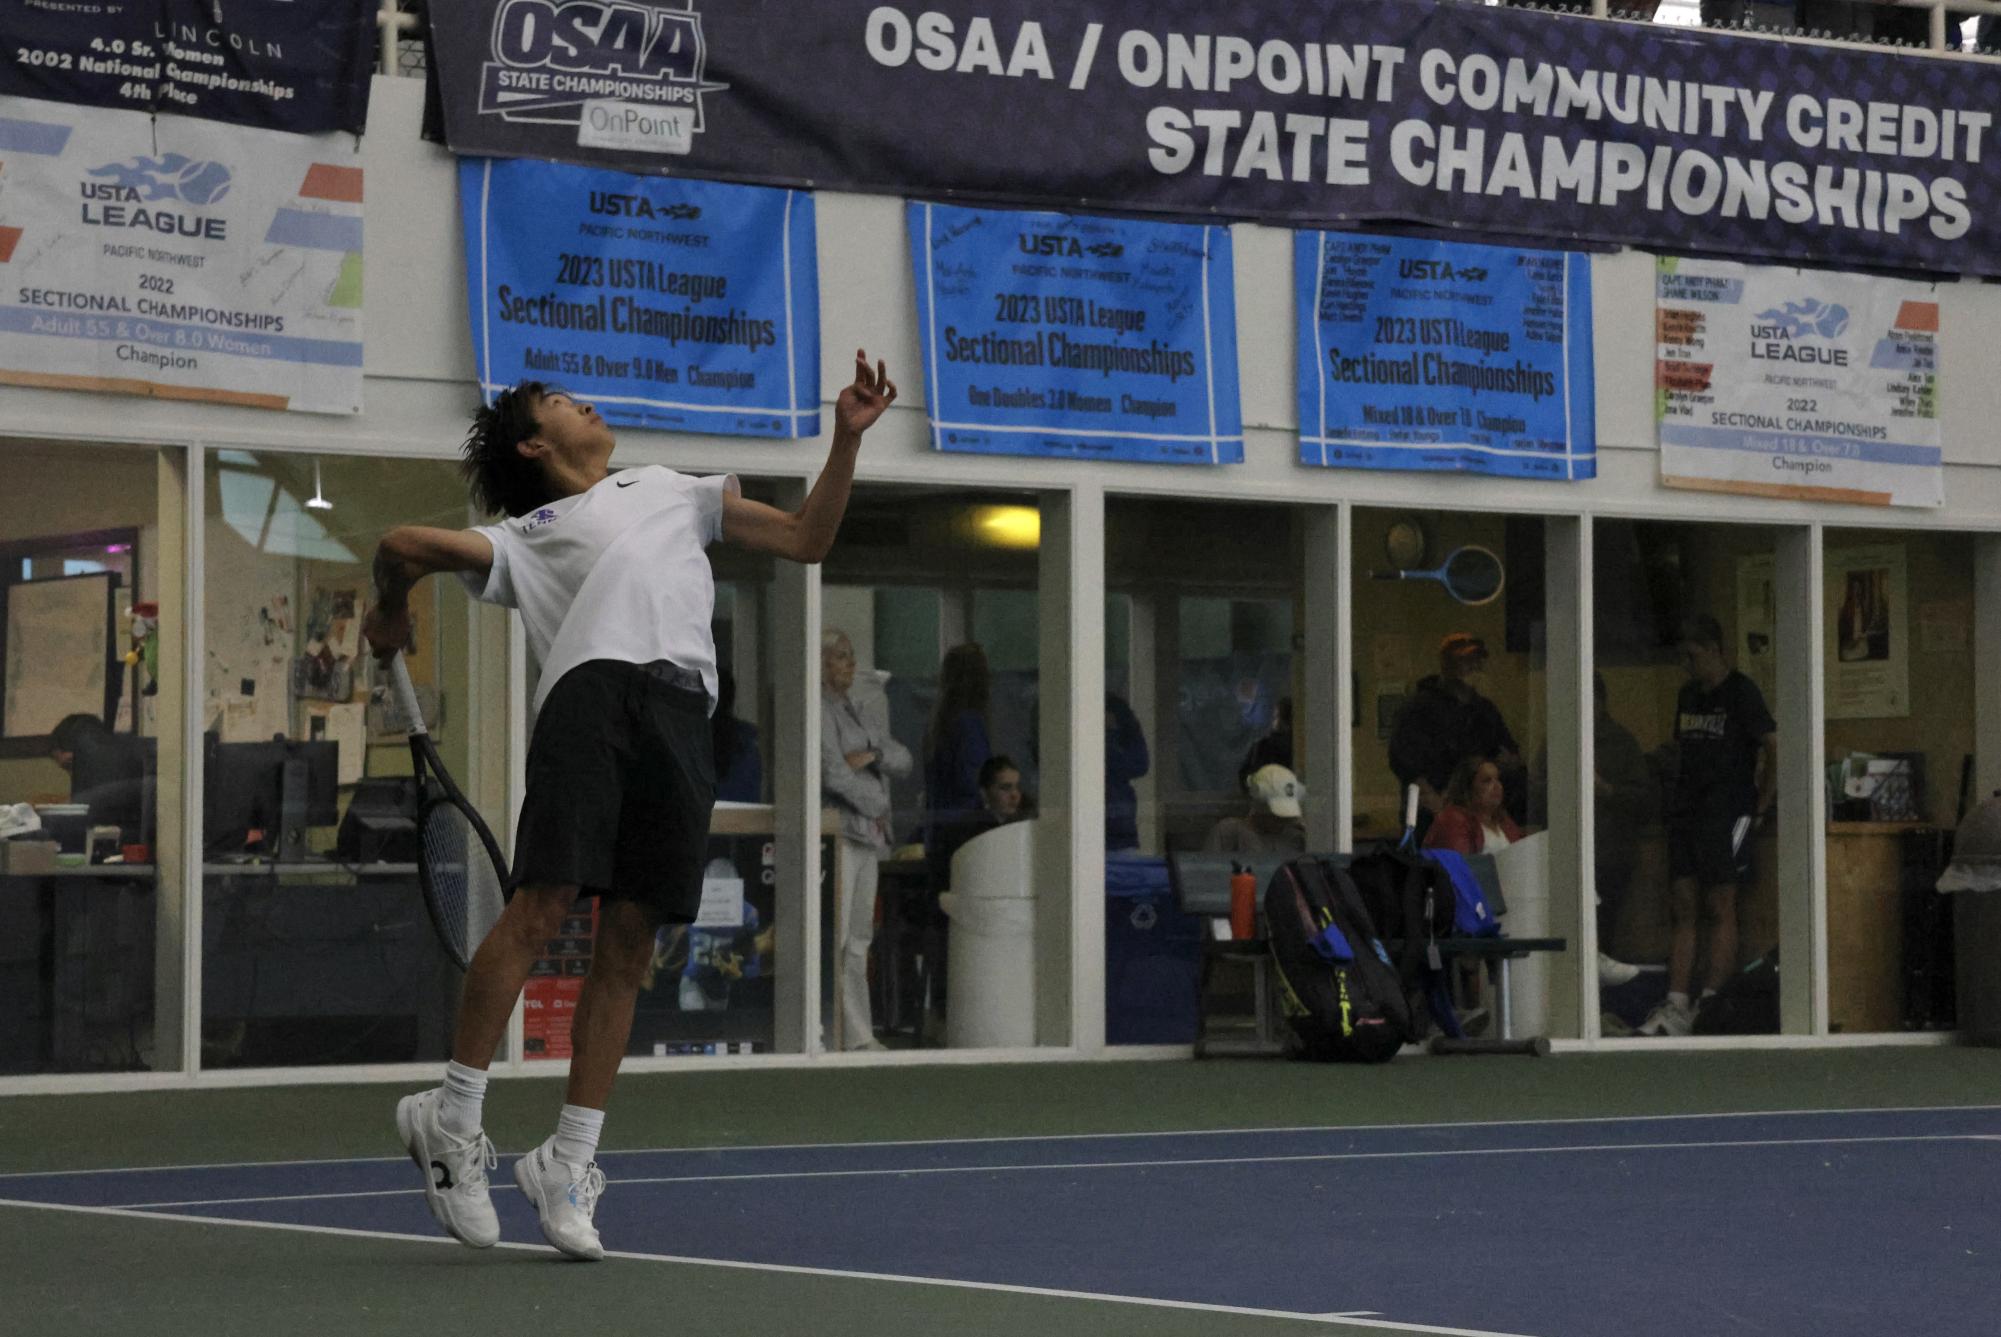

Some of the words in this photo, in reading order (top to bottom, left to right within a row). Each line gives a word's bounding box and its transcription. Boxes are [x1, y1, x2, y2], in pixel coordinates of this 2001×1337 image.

[107, 5, 123, 14] BY
[90, 37, 126, 54] 4.0
[131, 41, 156, 57] Sr.
[154, 21, 283, 59] LINCOLN
[495, 0, 702, 80] OSAA
[17, 48, 72, 69] 2002
[79, 55, 160, 79] National
[119, 81, 152, 100] 4th
[498, 71, 550, 90] STATE
[553, 76, 695, 103] CHAMPIONSHIPS
[864, 6, 1054, 80] OSAA
[1069, 23, 1103, 89] /
[1117, 30, 1404, 102] ONPOINT
[1420, 48, 1776, 141] COMMUNITY
[1786, 94, 1991, 163] CREDIT
[590, 106, 681, 137] OnPoint
[1145, 106, 1370, 185] STATE
[1390, 119, 1971, 240] CHAMPIONSHIPS
[81, 182, 141, 203] USTA
[589, 191, 656, 220] USTA
[82, 203, 226, 240] LEAGUE
[103, 244, 145, 260] PACIFIC
[147, 248, 206, 269] NORTHWEST
[1018, 233, 1084, 258] USTA
[139, 274, 174, 294] 2022
[556, 253, 604, 287] 2023
[609, 258, 656, 290] USTA
[658, 263, 728, 303] League
[1400, 258, 1456, 281] USTA
[19, 288, 131, 312] SECTIONAL
[137, 298, 284, 333] CHAMPIONSHIPS
[498, 285, 606, 333] Sectional
[611, 294, 777, 353] Championships
[994, 293, 1041, 324] 2023
[1045, 296, 1085, 327] USTA
[1088, 299, 1146, 335] League
[31, 315, 81, 336] Adult
[1375, 315, 1417, 344] 2023
[1458, 319, 1509, 356] League
[1751, 324, 1790, 340] USTA
[115, 344, 198, 370] Champion
[595, 354, 629, 378] Over
[944, 326, 1044, 367] Sectional
[1049, 331, 1195, 383] Championships
[1751, 342, 1848, 366] LEAGUE
[1329, 347, 1419, 385] Sectional
[1423, 352, 1555, 402] Championships
[1786, 398, 1817, 413] 2022
[1712, 411, 1782, 431] SECTIONAL
[1786, 418, 1887, 440] CHAMPIONSHIPS
[1772, 456, 1833, 474] Champion
